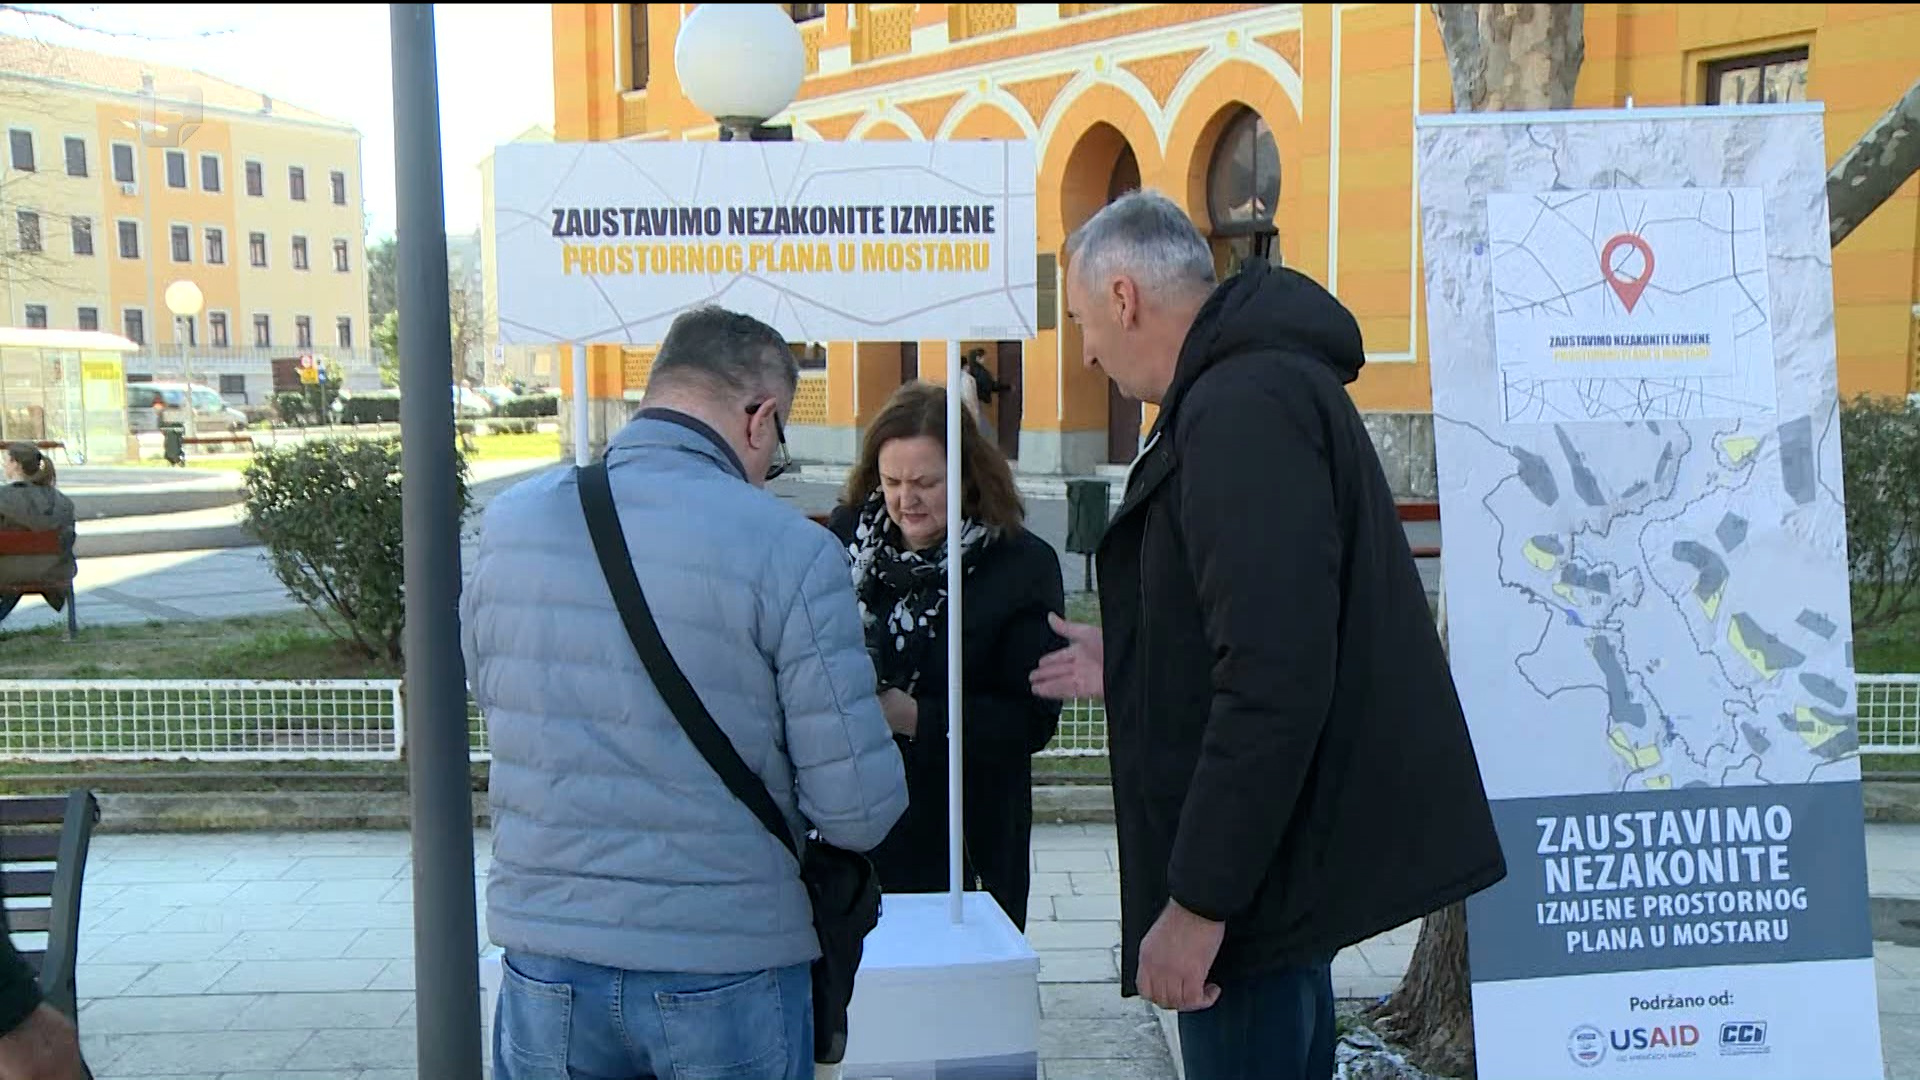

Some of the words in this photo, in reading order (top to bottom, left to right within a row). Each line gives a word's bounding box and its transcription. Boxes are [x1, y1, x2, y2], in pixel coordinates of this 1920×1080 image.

[552, 206, 722, 237] ZAUSTAVIMO
[728, 205, 885, 236] NEZAKONITE
[891, 205, 996, 235] IZMJENE
[563, 243, 743, 275] PROSTORNOG
[749, 242, 833, 273] PLANA
[838, 242, 856, 272] U
[862, 241, 990, 272] MOSTARU
[1549, 335, 1612, 348] ZAUSTAVIMO
[1613, 333, 1670, 346] NEZAKONITE
[1672, 333, 1711, 346] IZMJENE
[1536, 804, 1793, 854] ZAUSTAVIMO
[1545, 845, 1790, 894] NEZAKONITE
[1537, 896, 1637, 925] IZMJENE
[1643, 887, 1808, 919] PROSTORNOG
[1567, 926, 1645, 954] PLANA
[1650, 924, 1665, 947] U
[1673, 918, 1789, 947] MOSTARU
[1629, 993, 1705, 1012] Podržano
[1708, 990, 1734, 1006] od:
[1610, 1024, 1700, 1051] USAID
